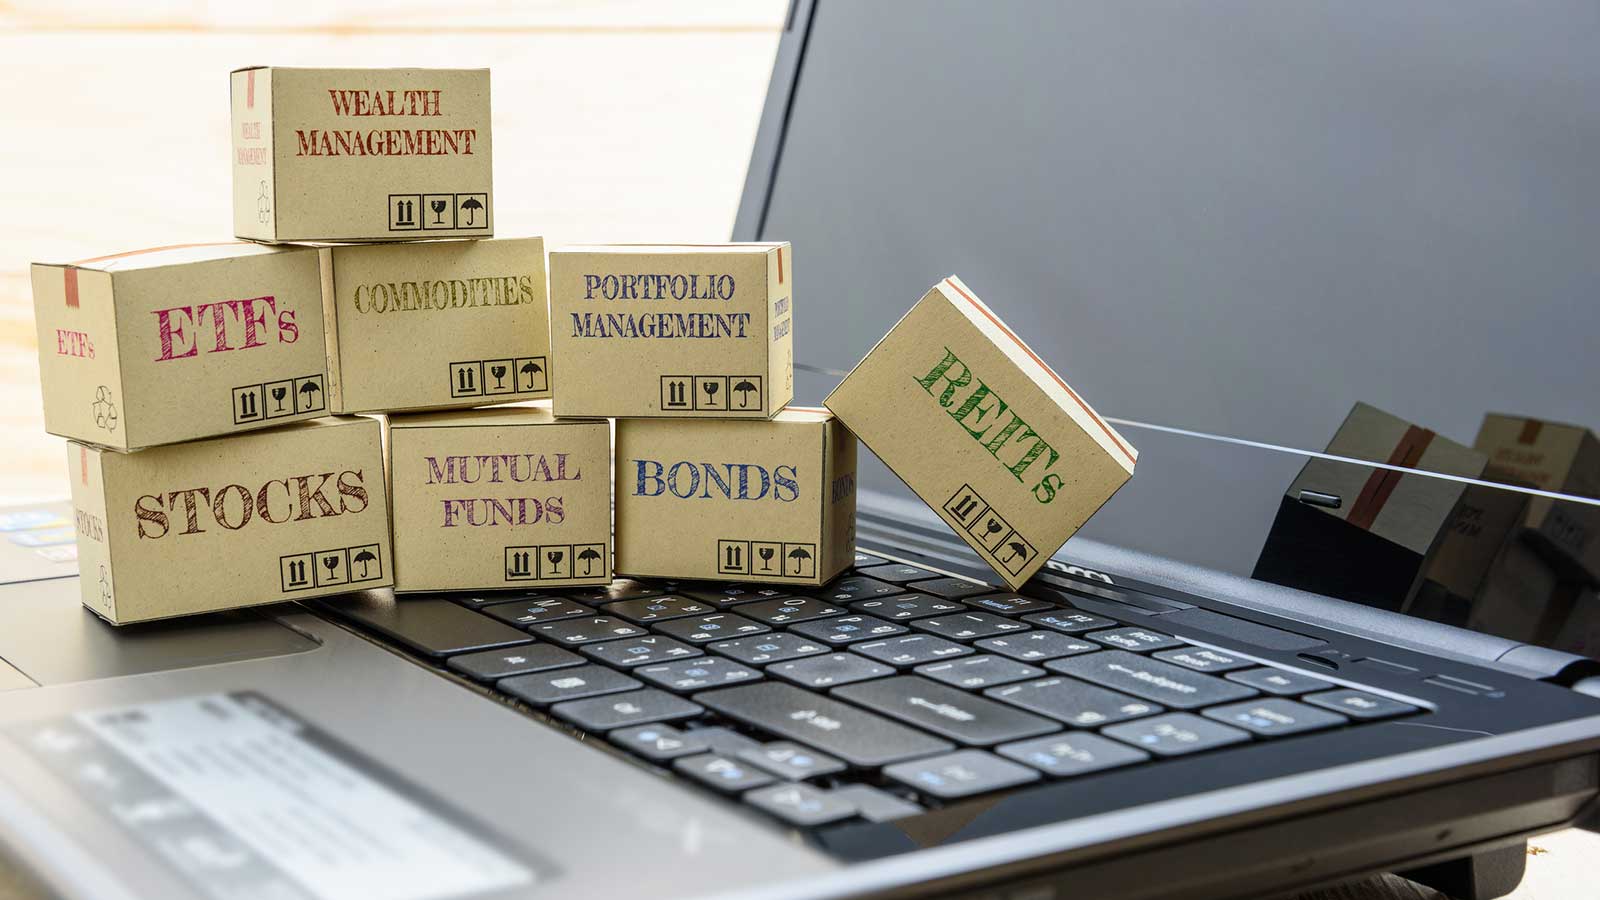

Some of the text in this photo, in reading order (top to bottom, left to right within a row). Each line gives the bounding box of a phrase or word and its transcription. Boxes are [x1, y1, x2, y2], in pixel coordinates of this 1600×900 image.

[328, 89, 442, 116] WEALTH
[296, 129, 476, 156] MANAGEMENT
[354, 275, 534, 314] COMMODITIES
[584, 274, 735, 300] PORTFOLIO
[151, 296, 299, 362] ETFs
[571, 312, 750, 338] MANAGEMENT
[56, 329, 96, 360] ETFs
[913, 346, 1065, 504] REITs
[425, 453, 581, 485] MUTUAL
[632, 459, 800, 502] BONDS
[135, 470, 369, 540] STOCKS
[441, 496, 565, 528] FUNDS
